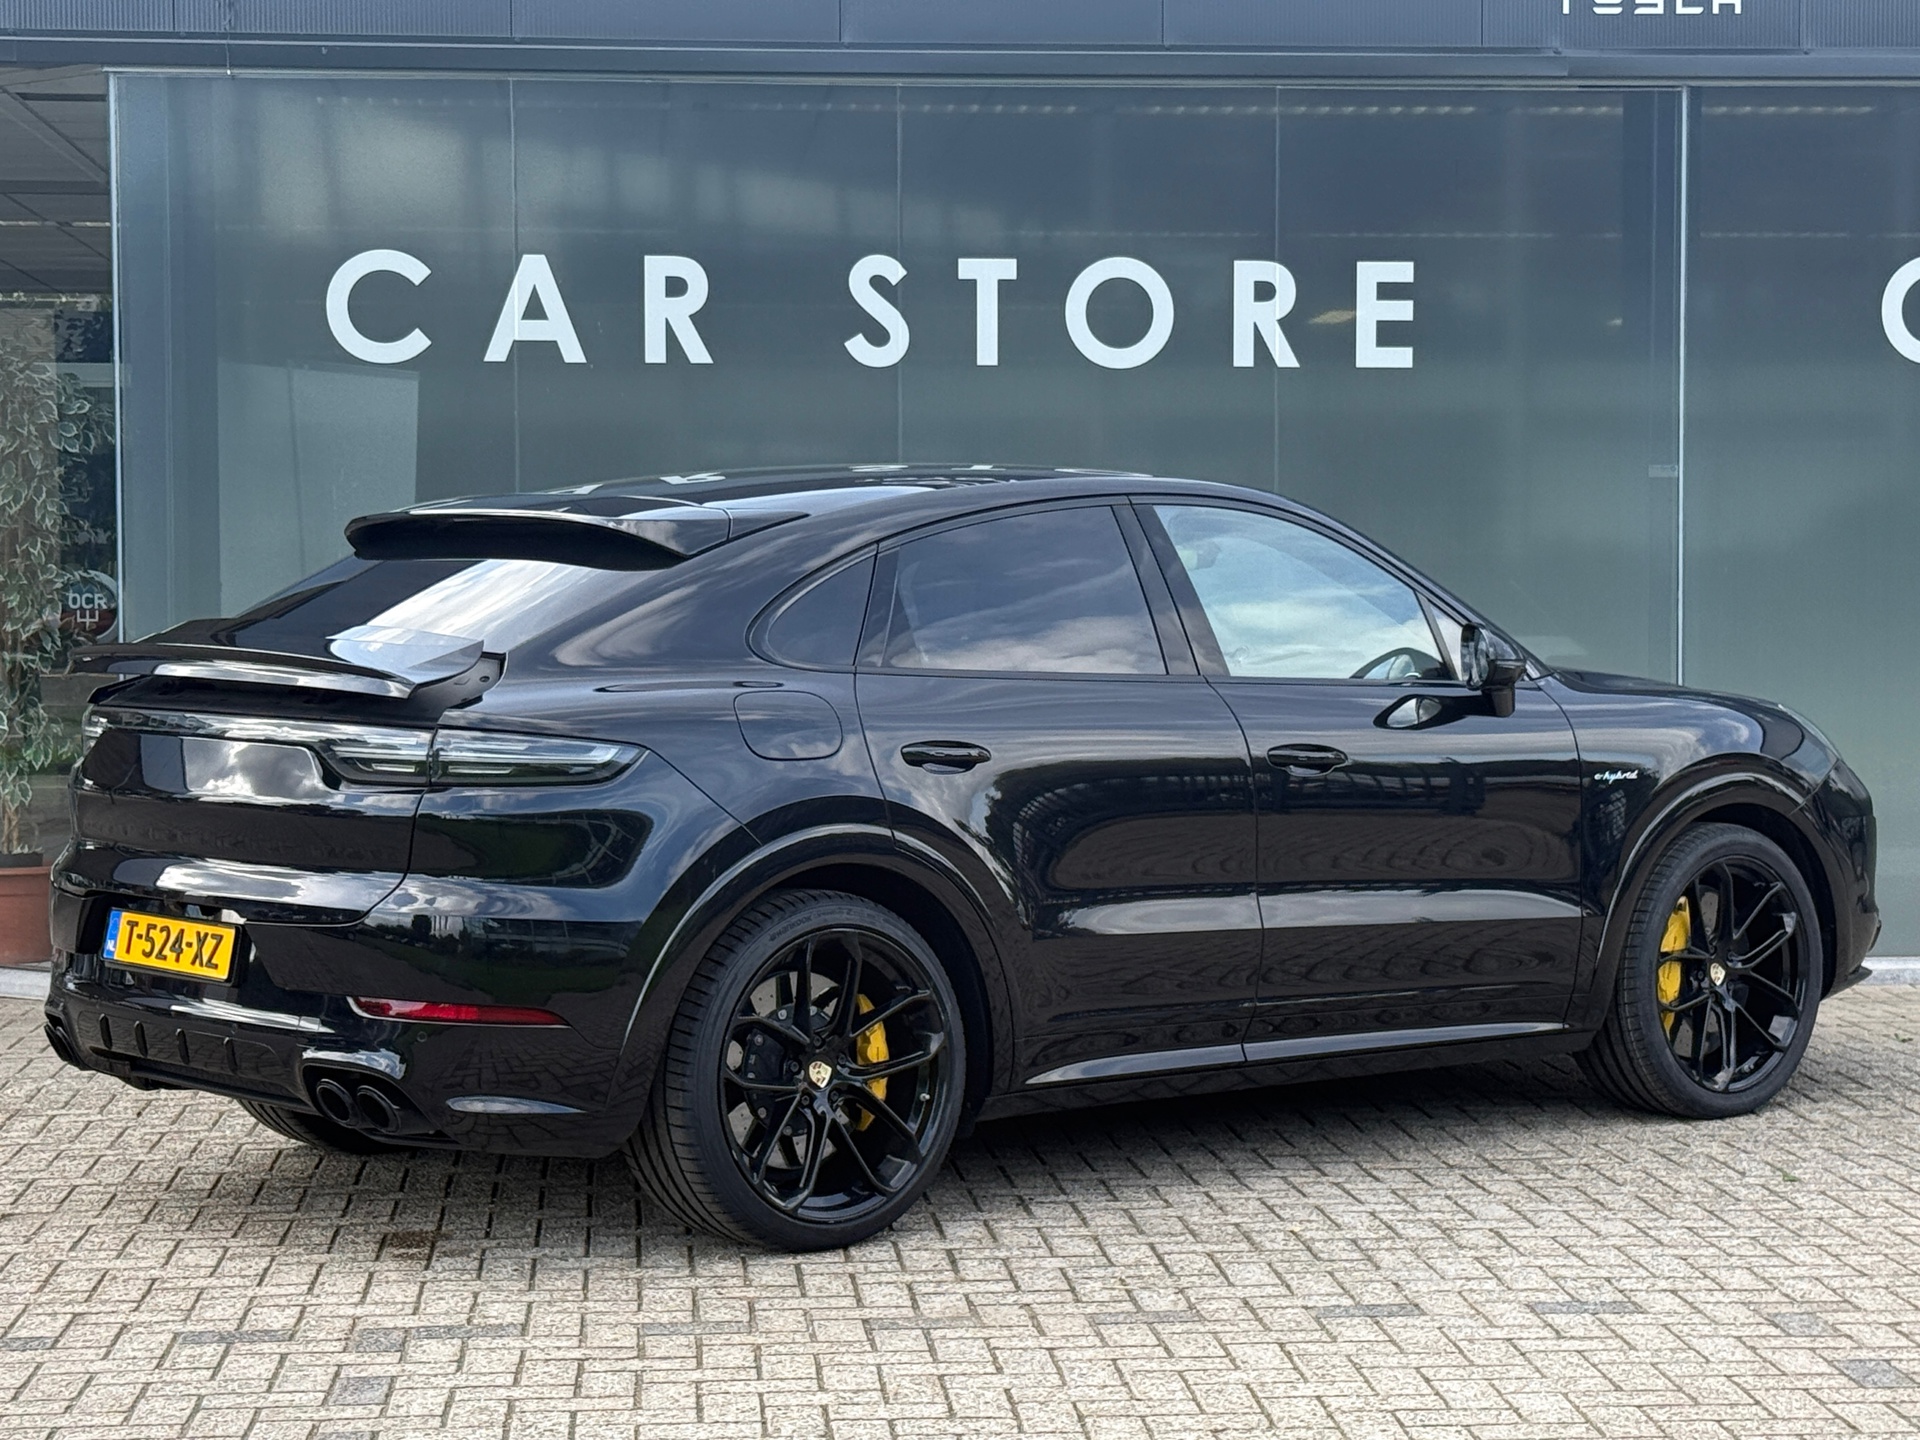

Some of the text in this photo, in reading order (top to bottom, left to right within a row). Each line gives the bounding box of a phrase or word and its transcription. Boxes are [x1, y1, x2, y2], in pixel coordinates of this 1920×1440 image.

[326, 249, 1415, 369] CAR STORE
[124, 919, 224, 970] T-524-XZ
